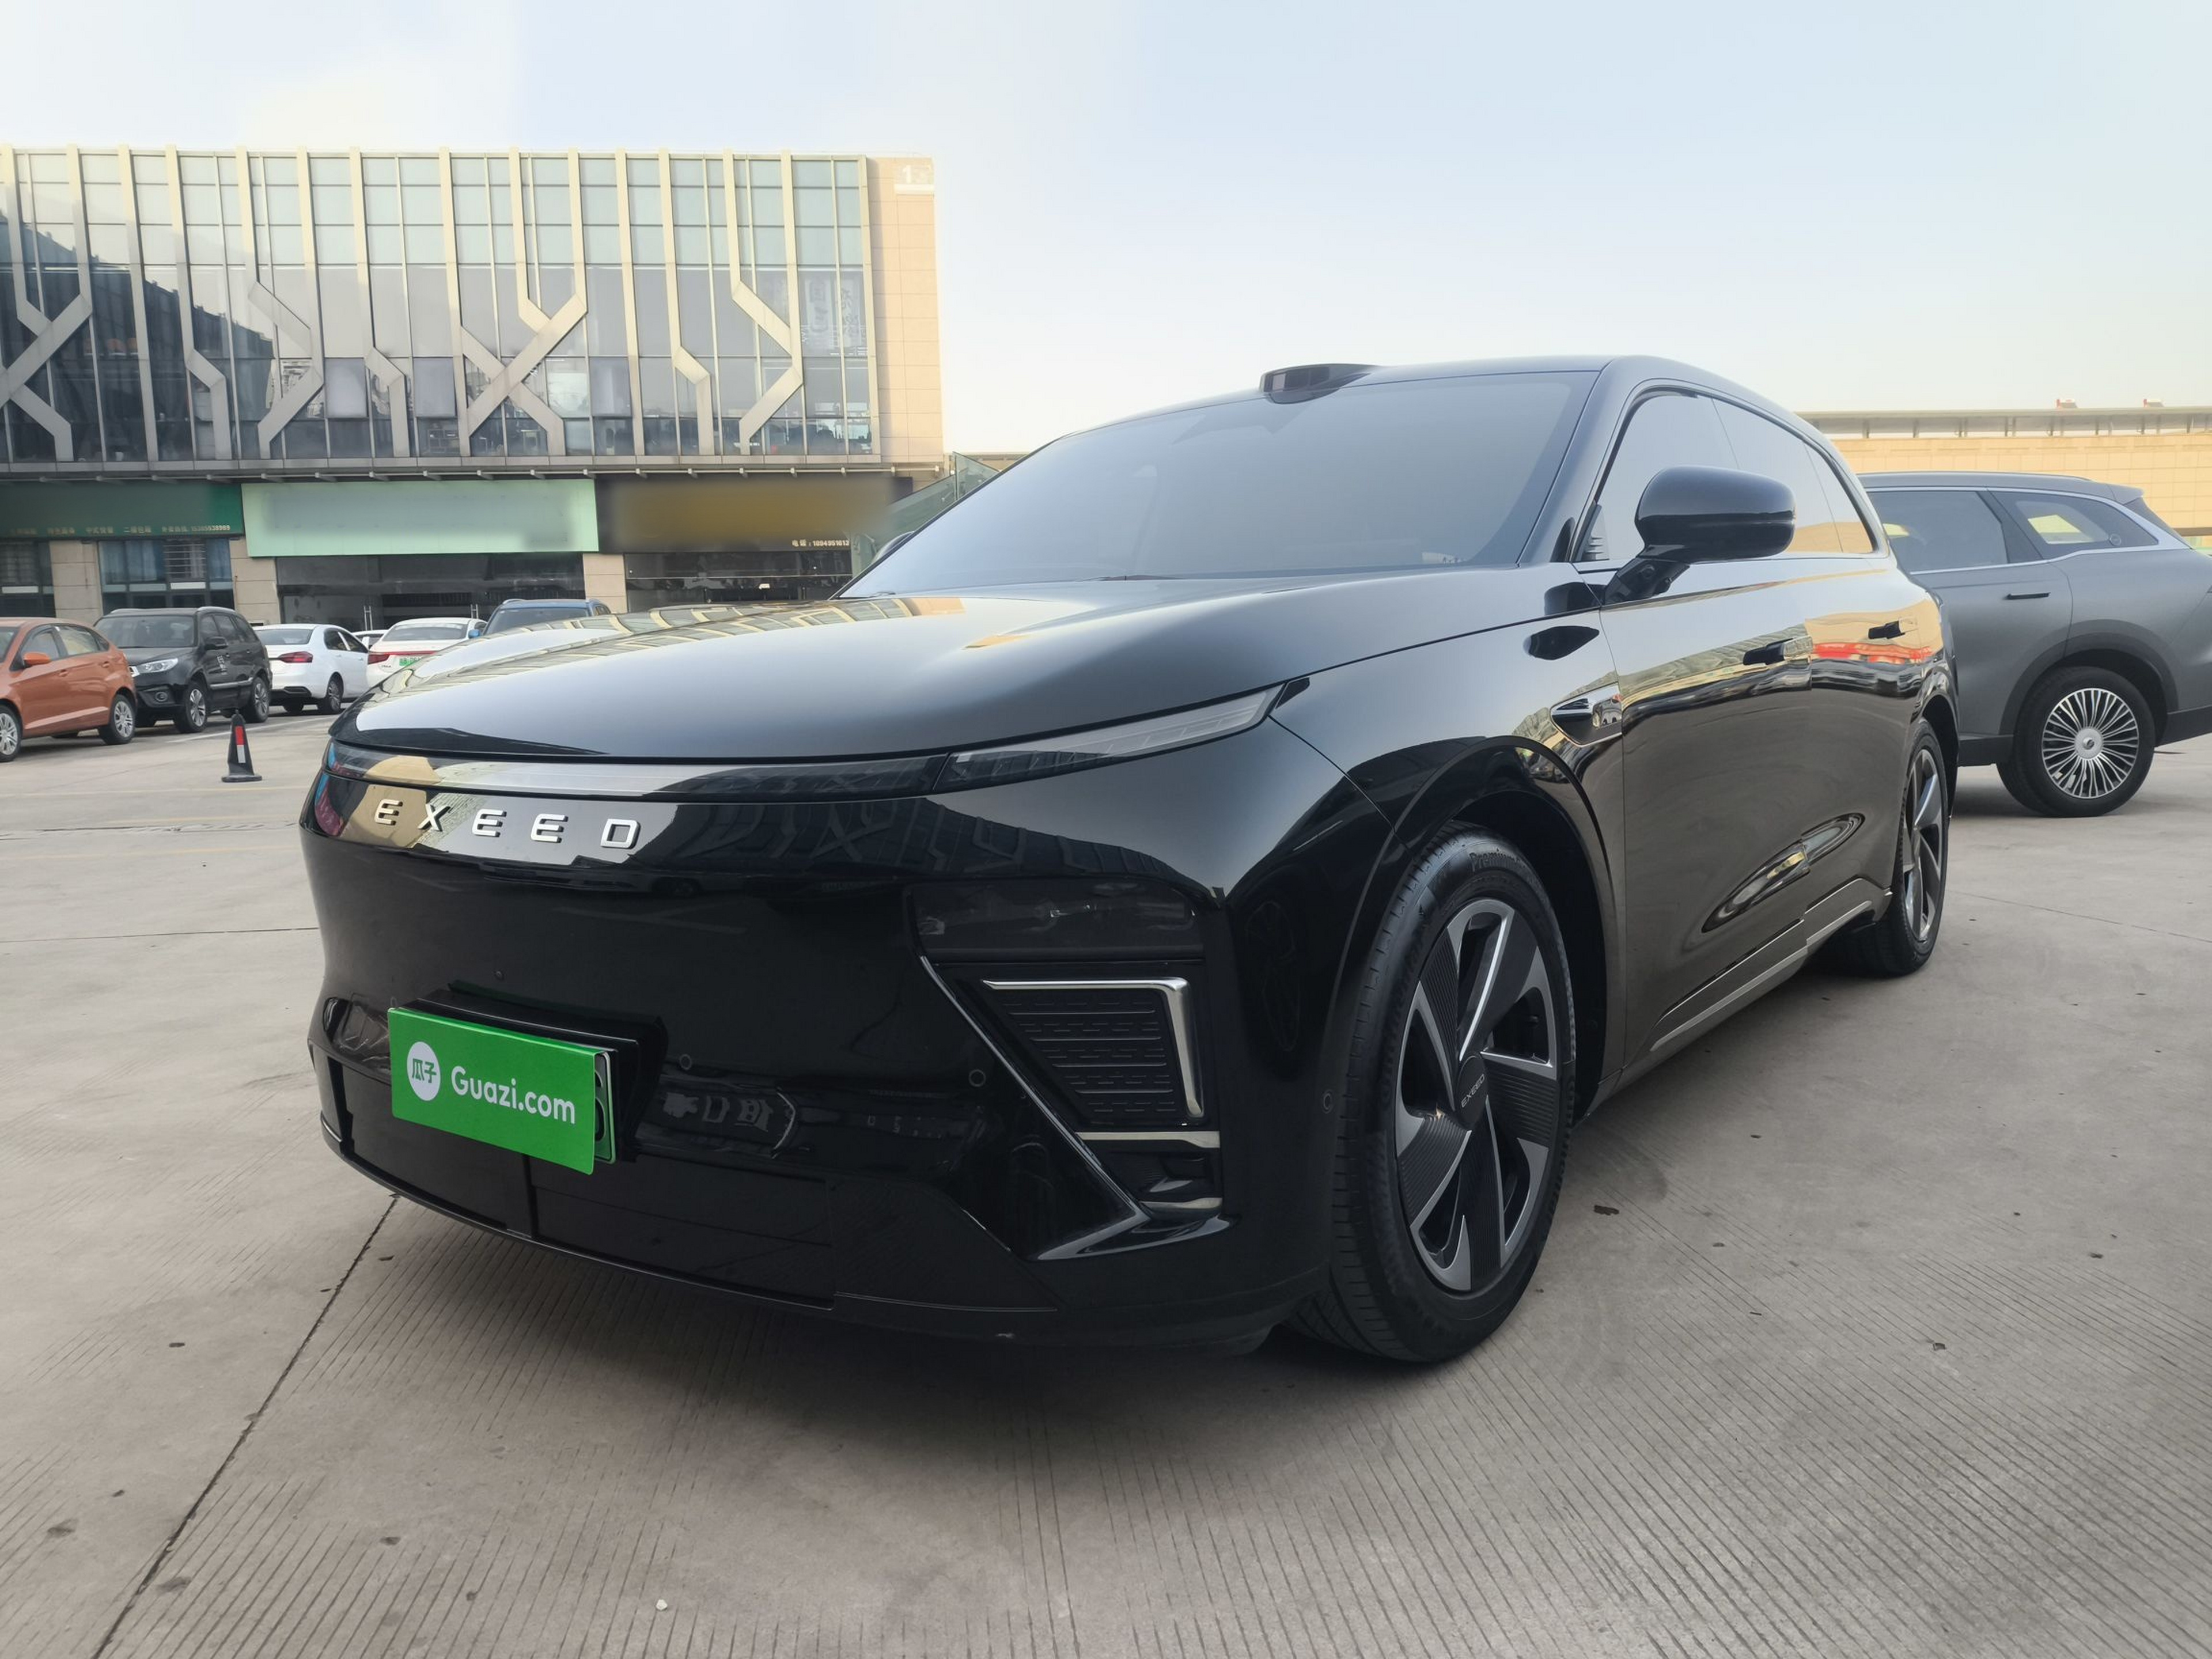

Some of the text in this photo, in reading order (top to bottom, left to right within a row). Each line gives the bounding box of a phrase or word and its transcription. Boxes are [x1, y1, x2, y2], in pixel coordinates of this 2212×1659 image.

[374, 798, 640, 849] EXEED
[412, 1058, 576, 1125] 瓜子 Guazi.com
[1461, 1074, 1485, 1108] EXEED
